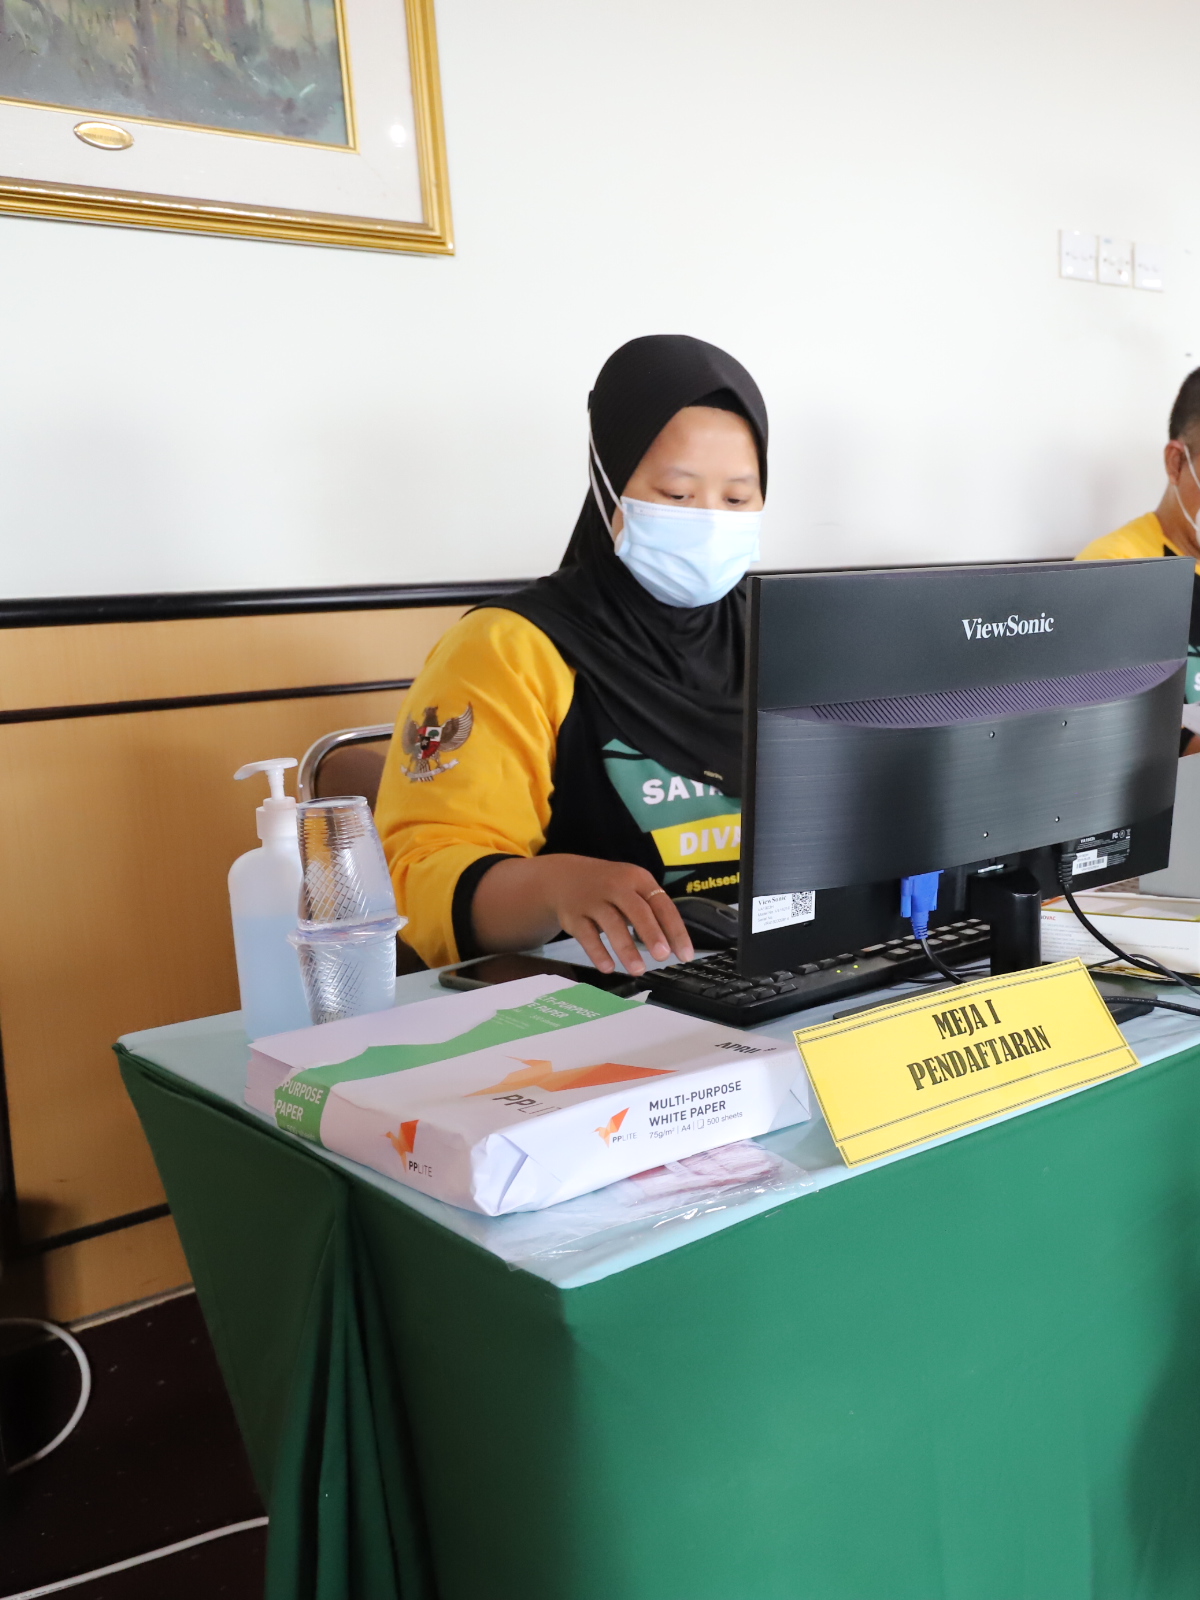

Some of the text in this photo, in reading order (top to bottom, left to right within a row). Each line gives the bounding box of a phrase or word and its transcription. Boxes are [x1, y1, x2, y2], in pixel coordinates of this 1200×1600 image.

[961, 612, 1055, 641] ViewSonic
[932, 998, 1001, 1040] MEJA I
[906, 1025, 1052, 1091] PENDAFTARAN
[649, 1080, 742, 1112] MULTI-PURPOSE
[275, 1099, 304, 1122] PAPER
[648, 1100, 727, 1127] WHITE PAPER
[681, 1123, 691, 1133] A4
[707, 1116, 720, 1126] 500
[721, 1111, 743, 1123] sheets
[612, 1131, 638, 1144] PPLITE
